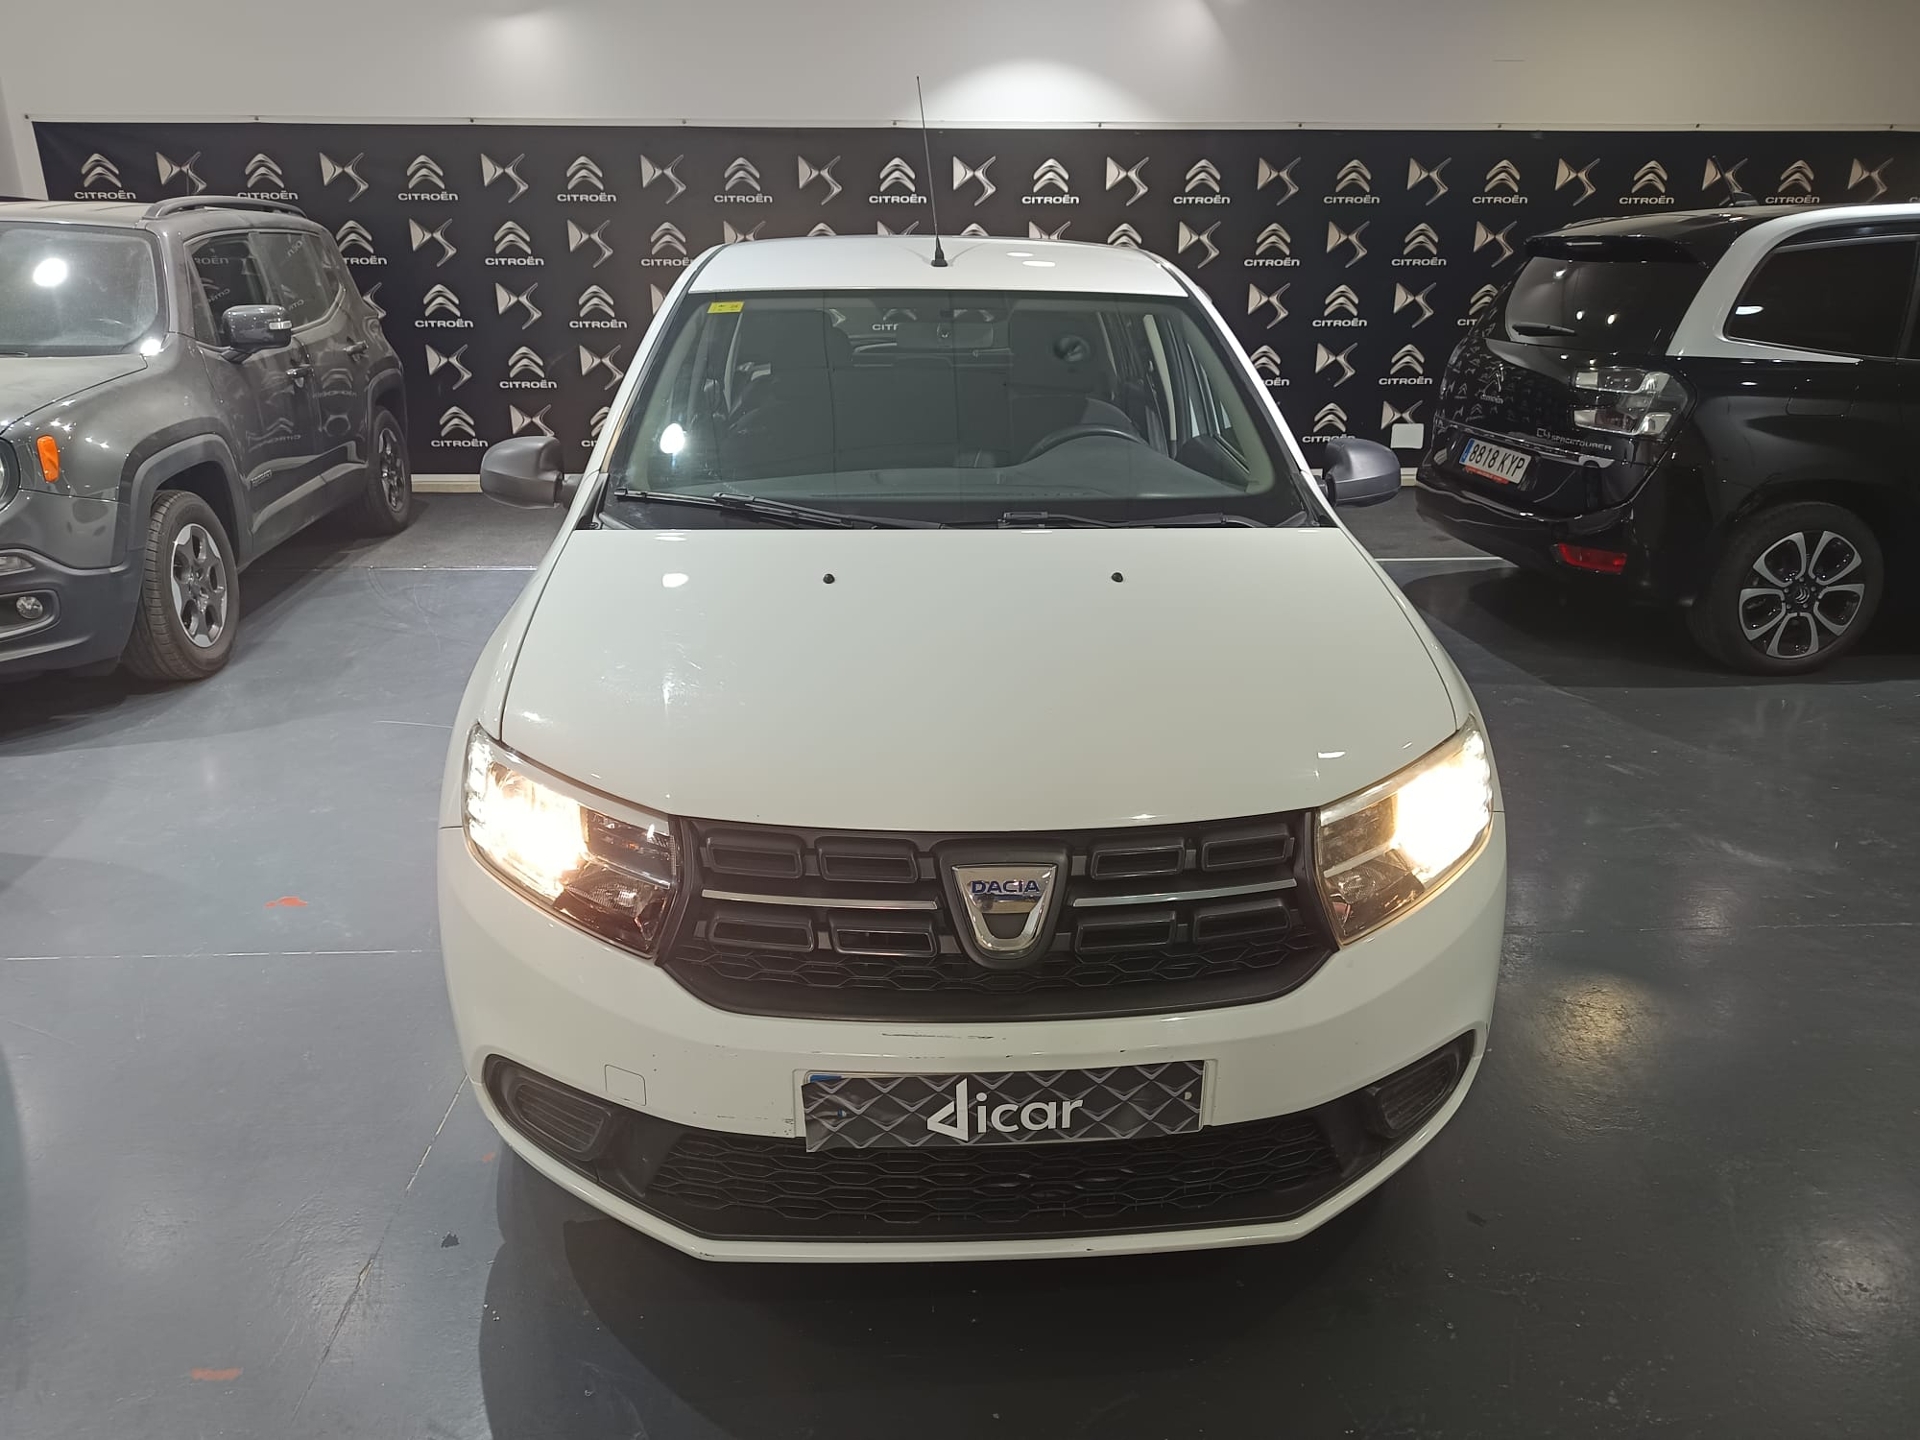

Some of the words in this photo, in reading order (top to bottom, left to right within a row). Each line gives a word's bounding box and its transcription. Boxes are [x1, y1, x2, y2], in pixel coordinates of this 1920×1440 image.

[344, 255, 388, 265] TROËN
[641, 257, 692, 267] CITROË
[1469, 443, 1497, 468] 8818
[1496, 452, 1526, 477] KYP
[971, 879, 1040, 894] DACIA
[926, 1077, 1084, 1143] dicar
